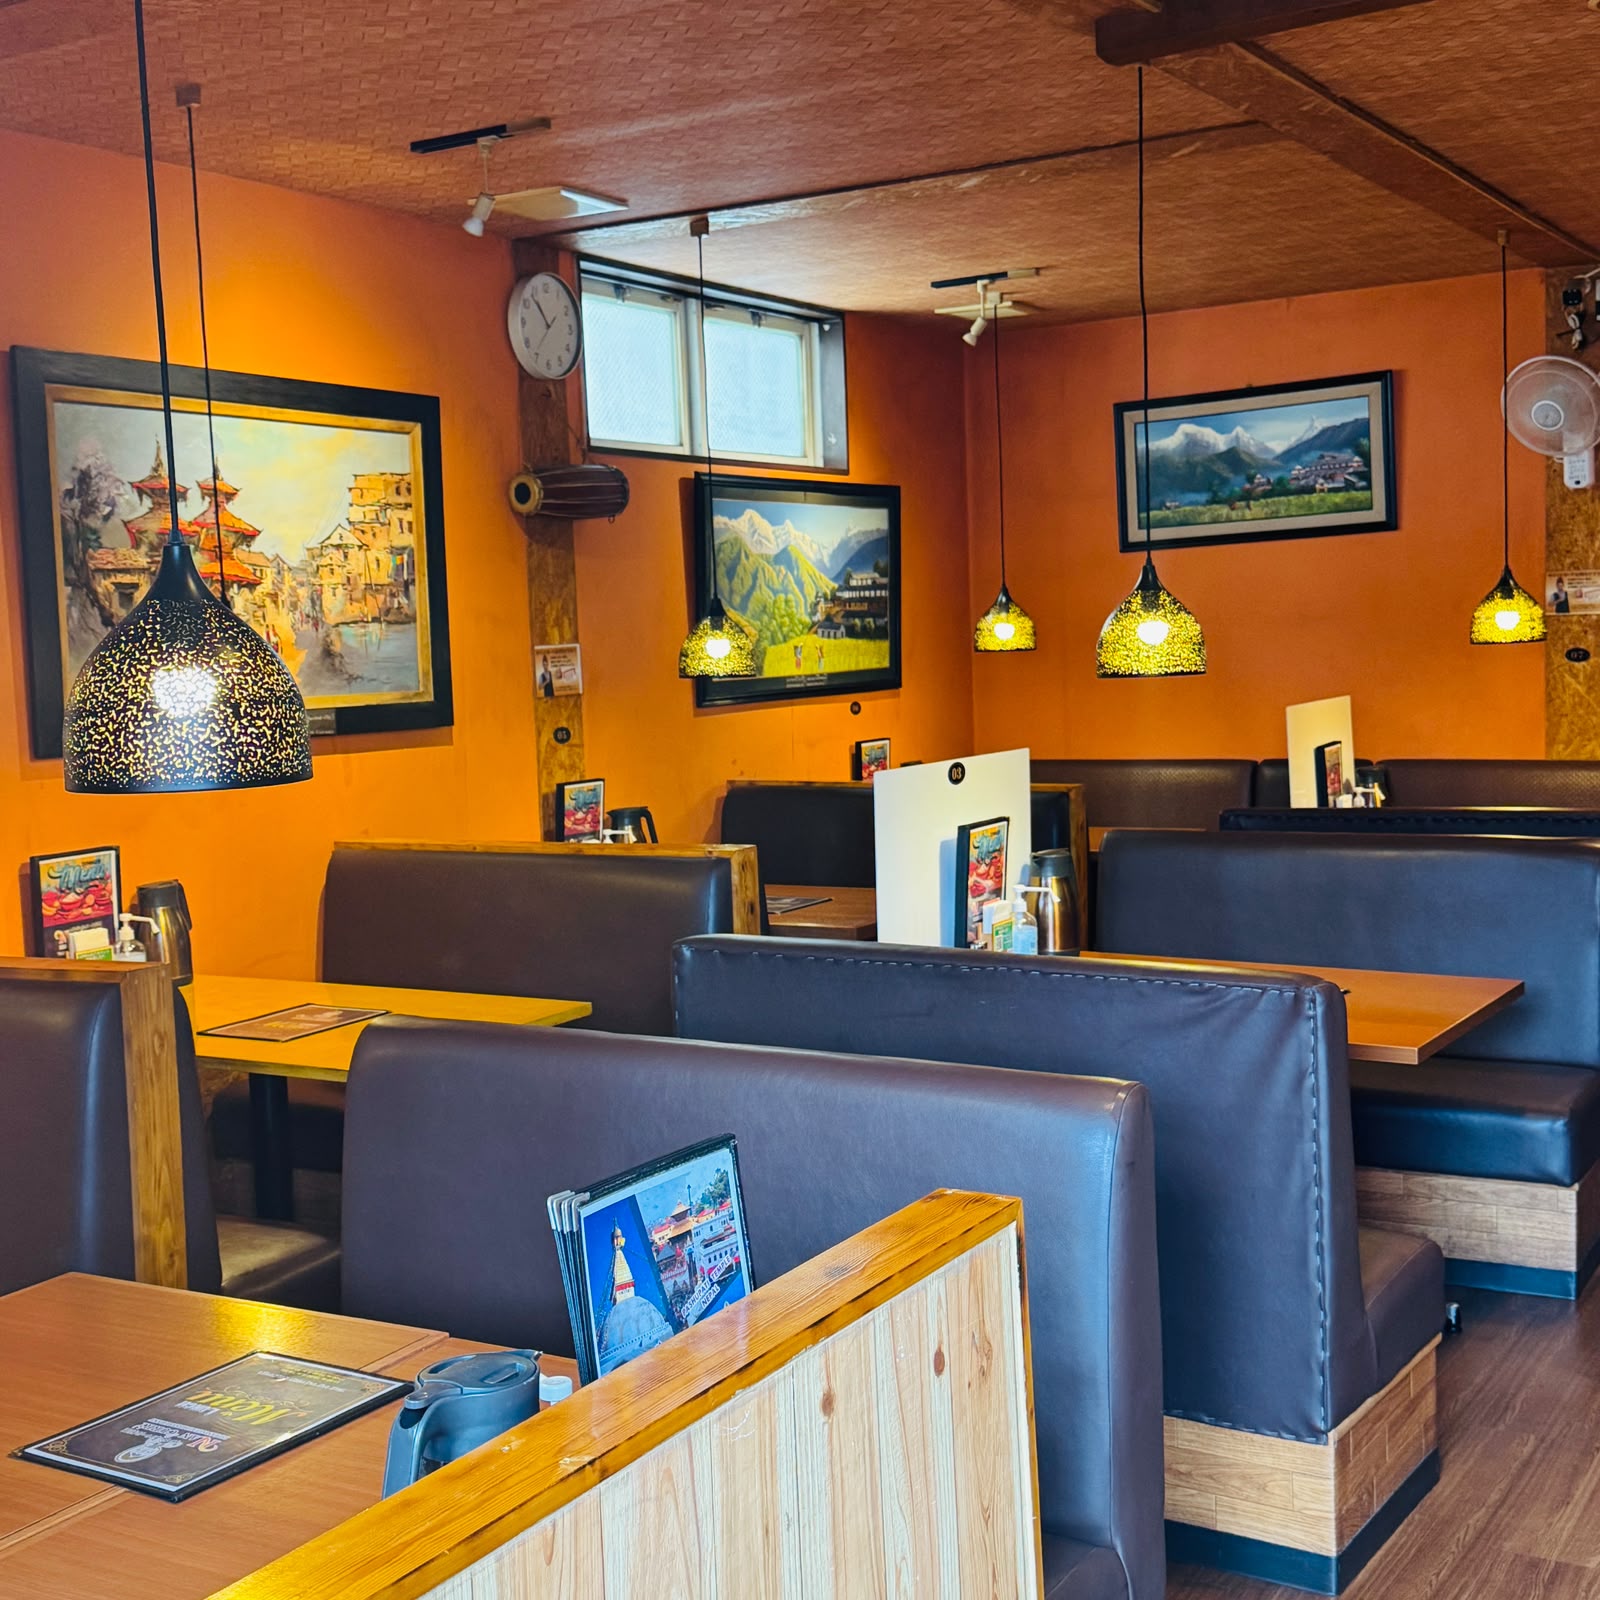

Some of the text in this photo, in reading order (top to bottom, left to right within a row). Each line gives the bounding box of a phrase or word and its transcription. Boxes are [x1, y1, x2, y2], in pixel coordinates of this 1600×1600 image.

[951, 767, 963, 780] 03
[681, 1255, 732, 1317] PASHUPATI TEMPLE
[701, 1284, 720, 1308] NEPAL
